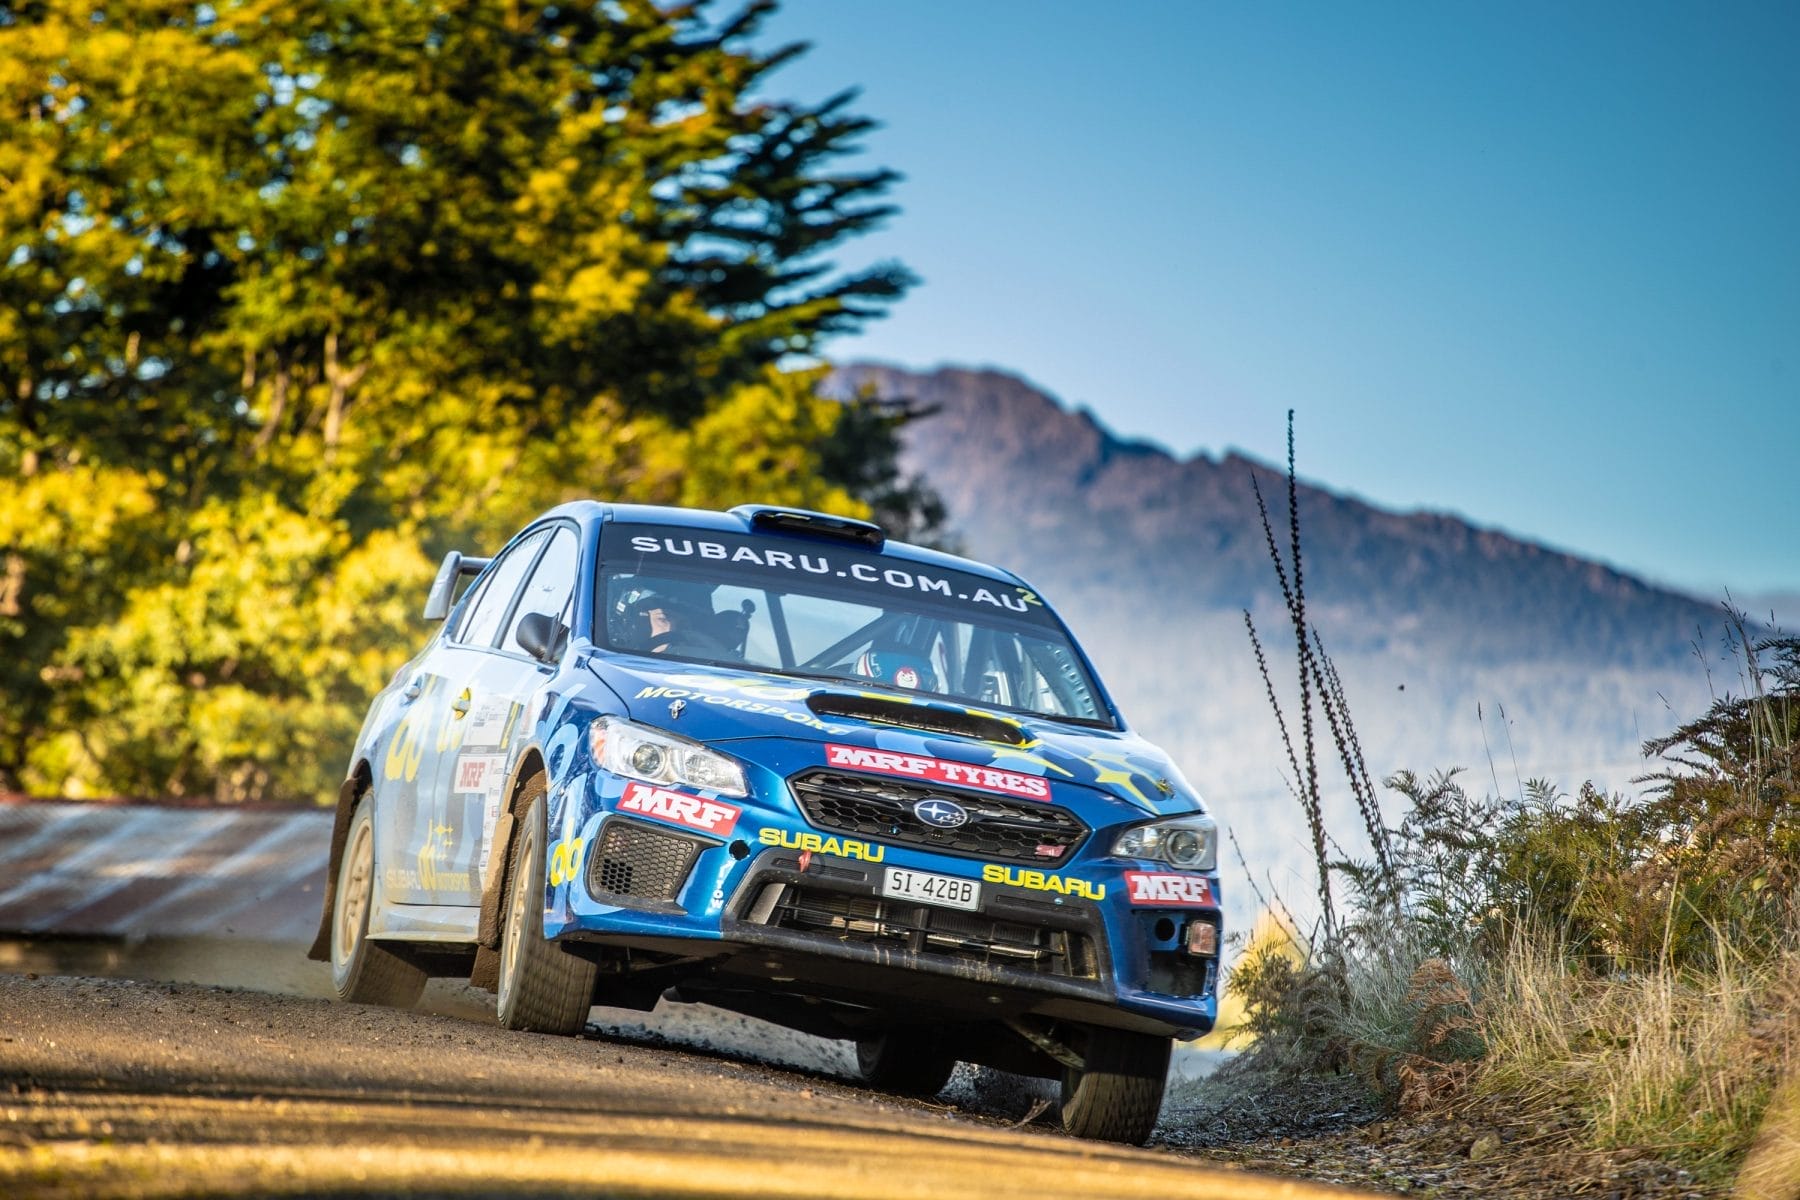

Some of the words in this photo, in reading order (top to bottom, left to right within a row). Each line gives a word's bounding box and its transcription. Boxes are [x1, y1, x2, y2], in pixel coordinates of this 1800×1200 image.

[631, 534, 1028, 612] SUBARU.COM.AU
[1015, 586, 1042, 606] 2
[634, 686, 850, 735] MOTORSPORT
[459, 762, 486, 788] MRF
[829, 744, 937, 776] MRF
[939, 761, 1047, 797] TYRES
[623, 784, 736, 830] MRF
[759, 827, 885, 863] SUBARU
[983, 865, 1105, 901] SUBARU
[1131, 874, 1209, 903] MRF
